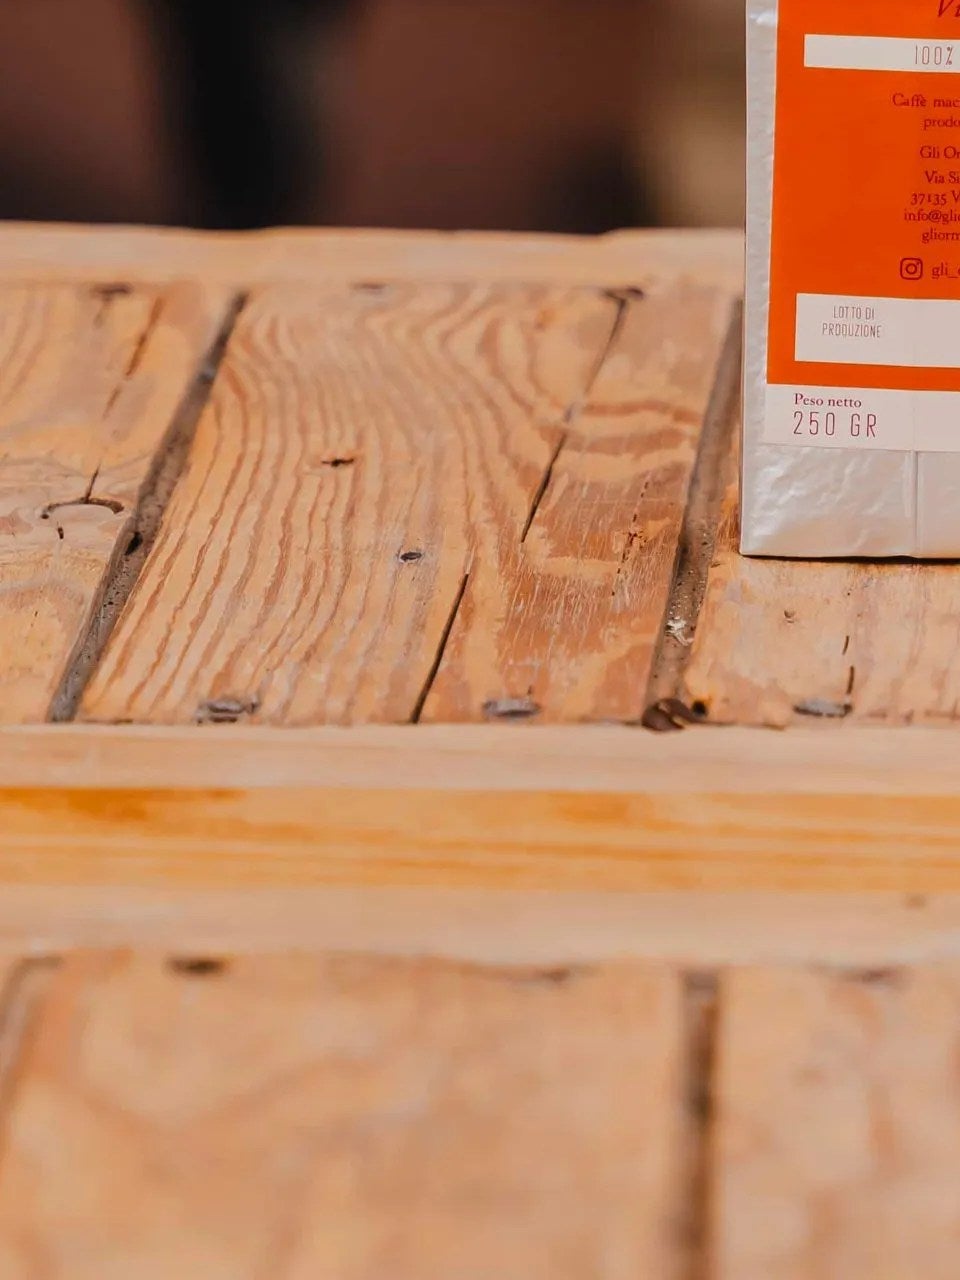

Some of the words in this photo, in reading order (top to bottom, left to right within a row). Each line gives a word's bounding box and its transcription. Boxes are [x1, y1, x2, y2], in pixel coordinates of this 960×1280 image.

[914, 45, 953, 66] 100%
[892, 93, 927, 107] Caffè
[919, 145, 940, 159] Gli
[925, 171, 945, 184] Via
[911, 192, 947, 206] 37135
[833, 306, 862, 320] LOTTO
[866, 307, 875, 321] DI
[822, 323, 882, 338] PRODUZIONE
[795, 393, 823, 407] Peso
[827, 394, 861, 408] netto
[793, 411, 836, 436] 250
[850, 413, 877, 437] GR
